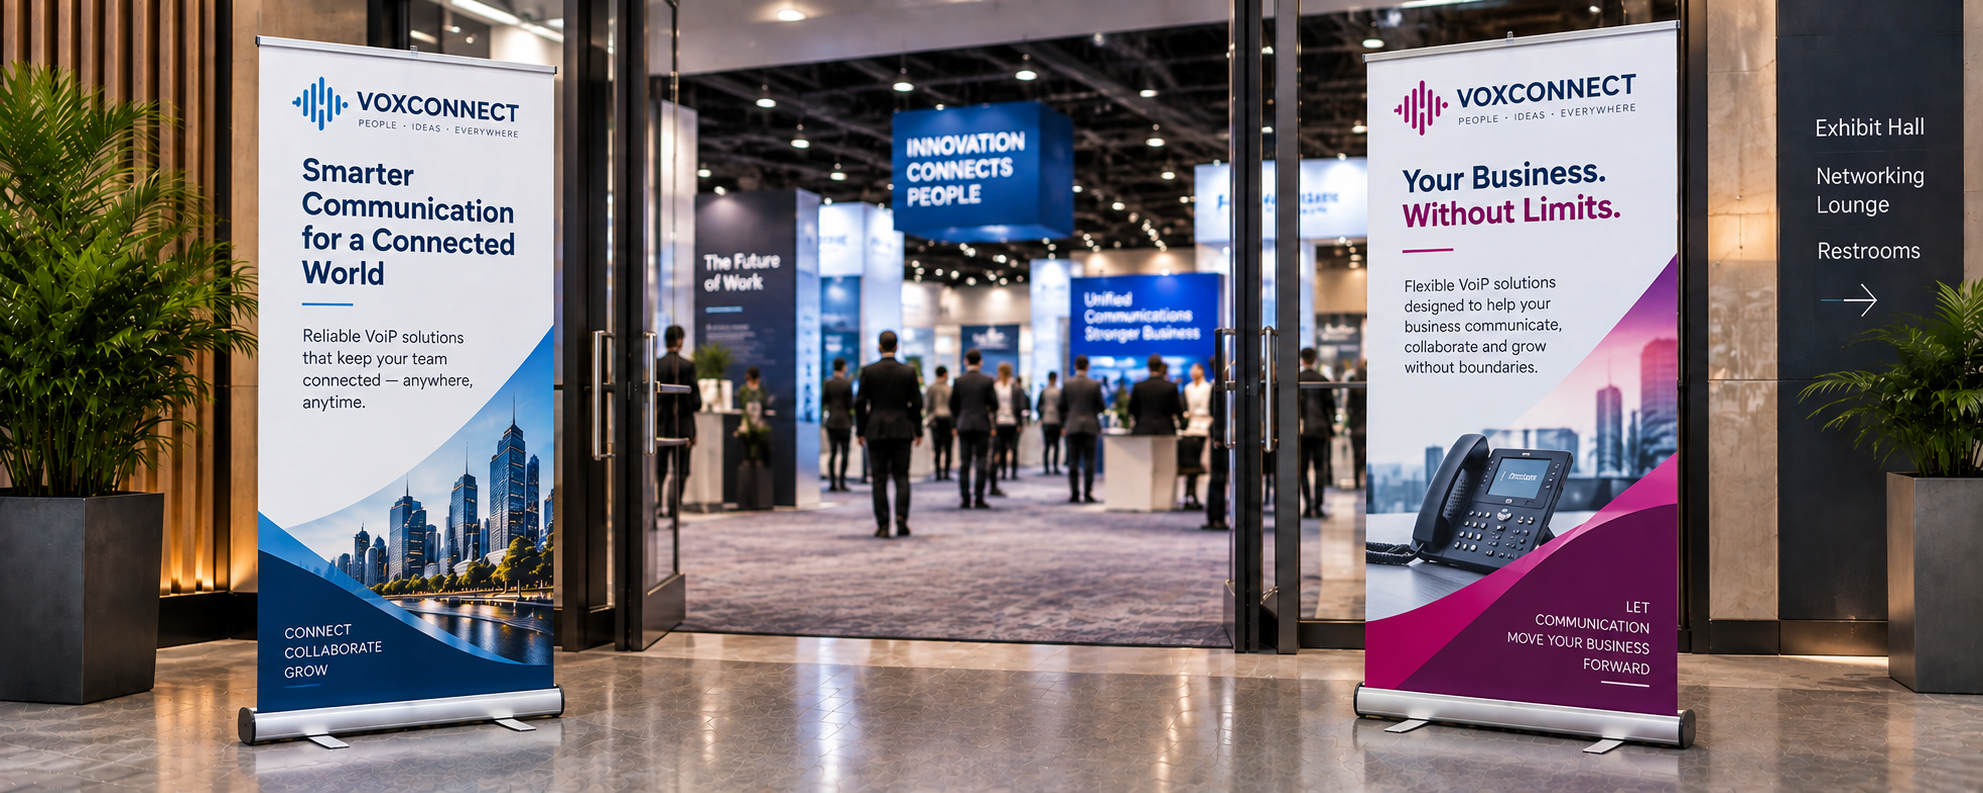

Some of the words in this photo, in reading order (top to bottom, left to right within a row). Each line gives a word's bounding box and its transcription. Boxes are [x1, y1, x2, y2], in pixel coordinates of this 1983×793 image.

[1457, 73, 1636, 108] VOXCONNECT
[357, 91, 519, 122] VOXCONNECT
[1458, 114, 1498, 125] PEOPLE
[1514, 111, 1545, 121] IDEAS
[1561, 103, 1636, 117] EVERYWHERE
[358, 119, 396, 129] PEOPLE
[412, 123, 441, 132] IDEAS
[455, 126, 518, 138] EVERYWHERE
[1816, 118, 1882, 137] Exhibit
[1889, 117, 1924, 135] Hall
[907, 132, 1025, 157] INNOVATION
[302, 158, 414, 186] Smarter
[906, 157, 1013, 182] CONNECTS
[1402, 169, 1464, 193] Your
[1473, 161, 1606, 189] Business.
[1817, 166, 1924, 188] Networking
[907, 184, 982, 207] PEOPLE
[302, 191, 514, 224] Communication
[1402, 200, 1515, 228] Without
[1524, 193, 1621, 222] Limits.
[1818, 196, 1889, 217] Lounge
[302, 225, 342, 250] for
[349, 233, 364, 251] a
[372, 228, 515, 256] Connected
[1819, 242, 1920, 259] Restrooms
[704, 254, 732, 271] The
[734, 253, 781, 269] Future
[302, 260, 384, 285] World
[704, 274, 721, 292] of
[723, 273, 763, 291] Work
[1405, 279, 1455, 292] Flexible
[1459, 277, 1489, 291] VoiP
[1494, 276, 1556, 290] solutions
[1084, 291, 1133, 307] Unified
[1404, 298, 1464, 315] designed
[1468, 300, 1482, 311] to
[1487, 297, 1516, 313] help
[1520, 300, 1551, 313] your
[1084, 307, 1193, 324] Communications
[1085, 326, 1140, 344] Stronger
[1142, 325, 1201, 340] Business
[1405, 320, 1461, 333] business
[1465, 318, 1562, 332] communicate,
[303, 328, 361, 343] Reliable
[365, 329, 397, 343] VoiP
[402, 330, 464, 344] solutions
[1404, 340, 1478, 353] collaborate
[1482, 339, 1507, 353] and
[1512, 342, 1547, 356] grow
[302, 351, 332, 365] that
[337, 350, 372, 368] keep
[376, 355, 408, 368] your
[412, 353, 447, 365] team
[1404, 360, 1454, 374] without
[1459, 360, 1538, 374] boundaries.
[303, 373, 380, 387] connected
[403, 373, 473, 390] anywhere,
[303, 395, 365, 412] anytime.
[1626, 601, 1650, 613] LET
[285, 624, 352, 639] CONNECT
[1535, 614, 1649, 634] COMMUNICATION
[285, 641, 382, 659] COLLABORATE
[1508, 632, 1544, 646] MOVE
[1547, 635, 1582, 649] YOUR
[1587, 638, 1650, 655] BUSINESS
[284, 664, 328, 679] GROW
[1584, 658, 1650, 675] FORWARD
